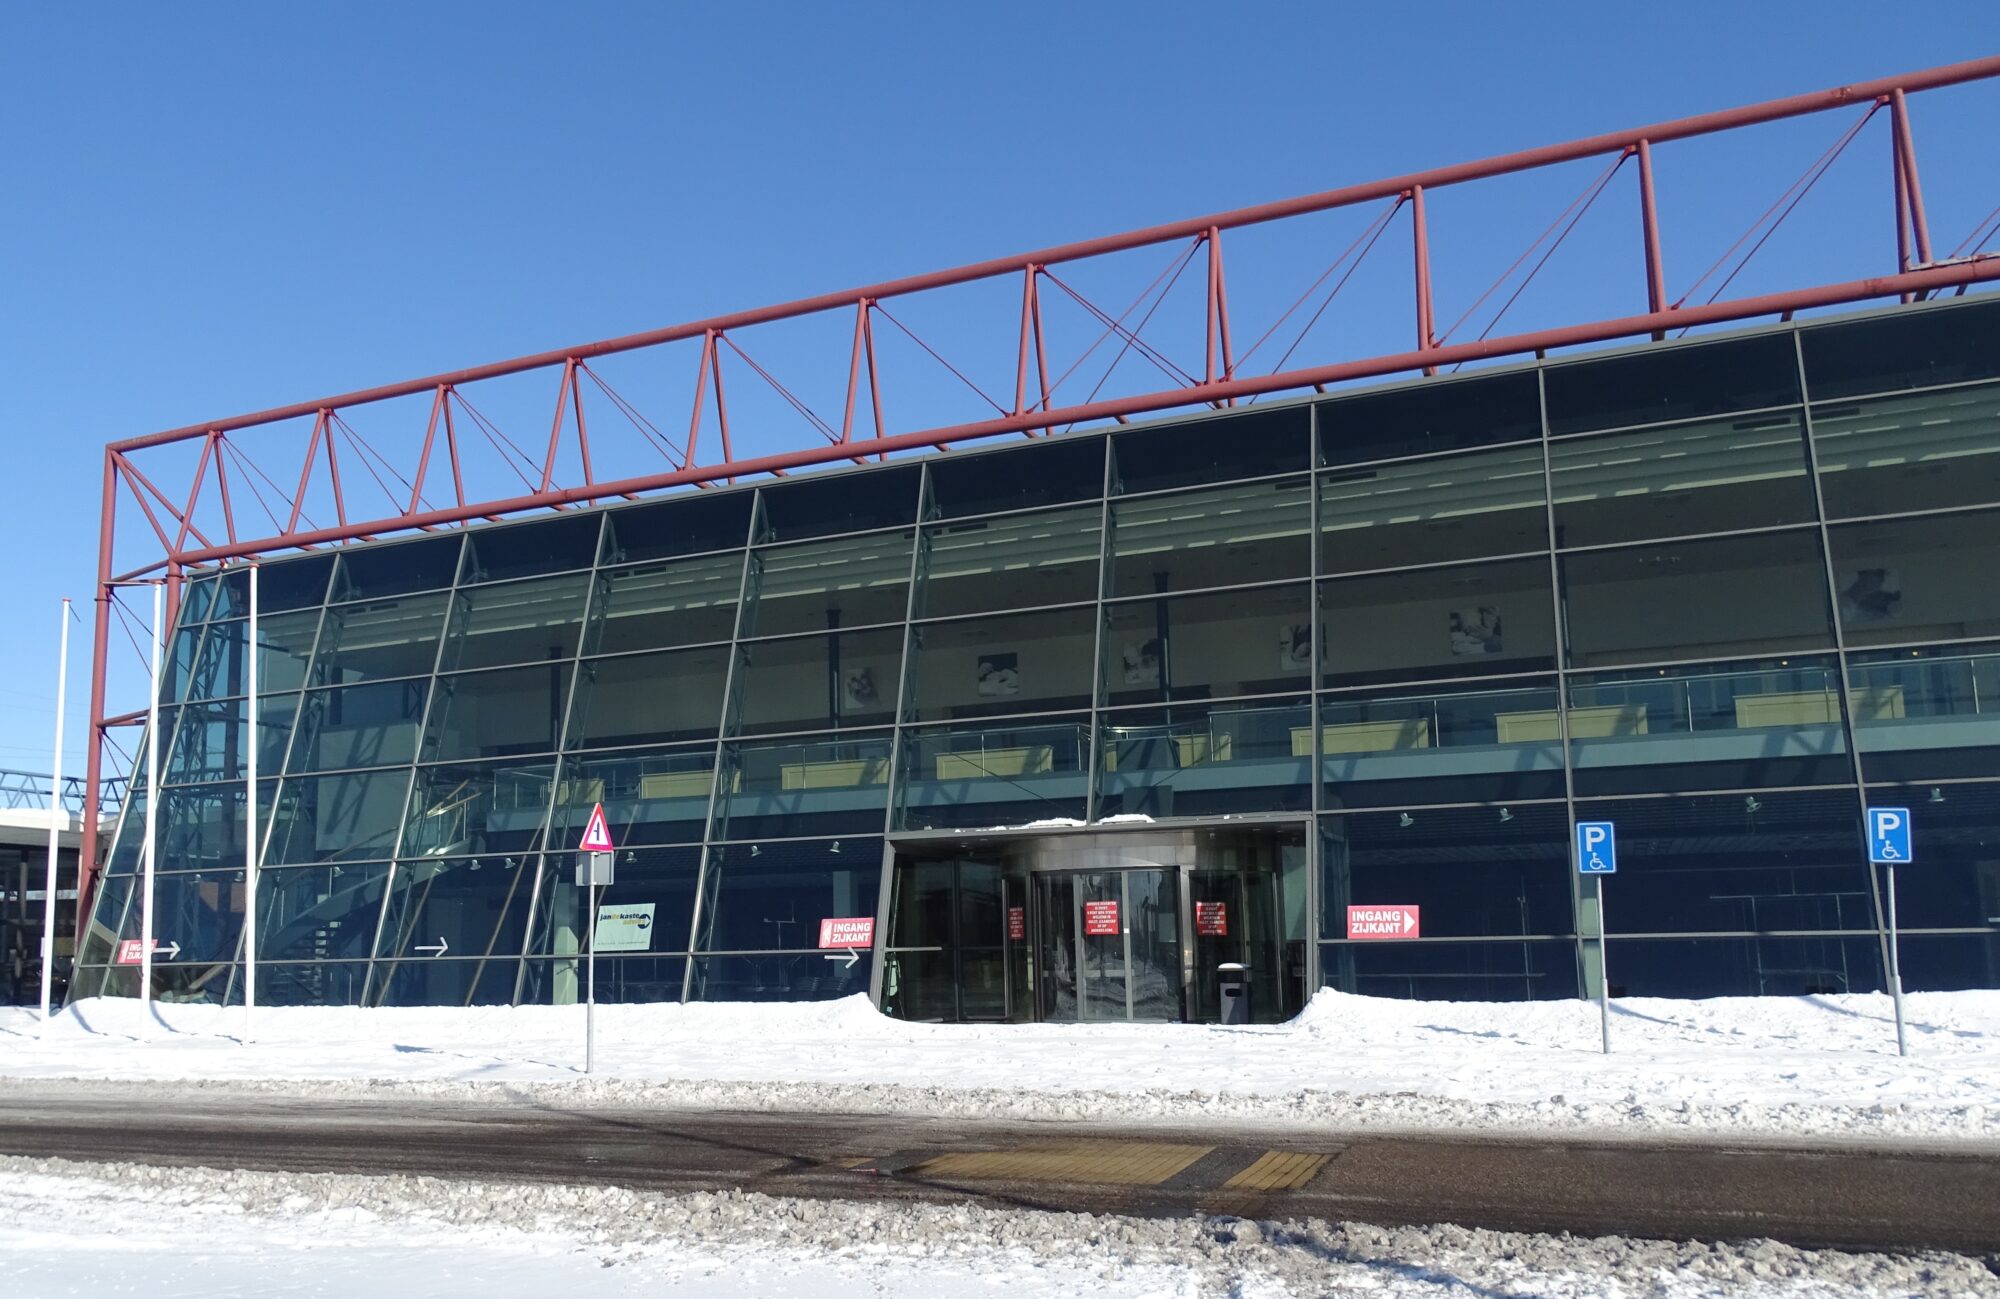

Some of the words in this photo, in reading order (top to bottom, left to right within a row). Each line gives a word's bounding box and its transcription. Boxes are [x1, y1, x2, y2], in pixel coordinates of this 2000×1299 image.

[1877, 812, 1900, 840] P
[1585, 826, 1606, 852] P
[1351, 910, 1401, 922] INGANG
[833, 922, 871, 933] INGANG
[1351, 922, 1401, 934] ZIJKANT
[831, 932, 869, 943] ZIJKANT
[129, 943, 155, 951] INGG
[126, 951, 152, 960] ZIJK
